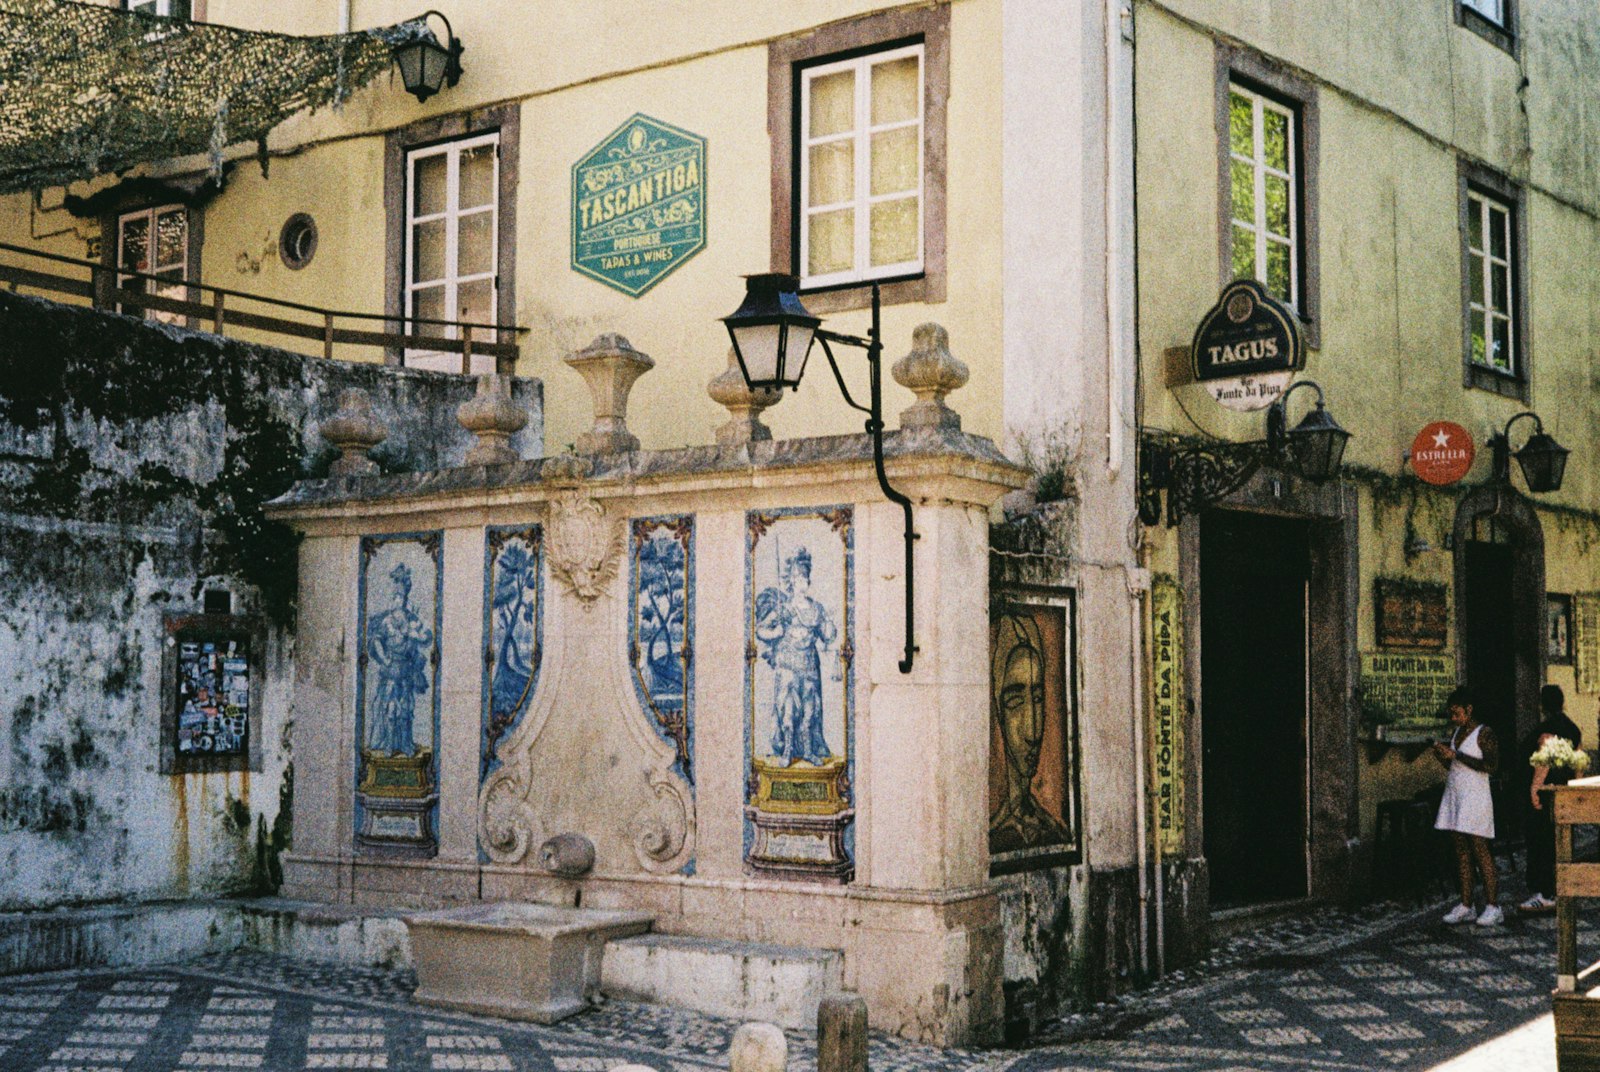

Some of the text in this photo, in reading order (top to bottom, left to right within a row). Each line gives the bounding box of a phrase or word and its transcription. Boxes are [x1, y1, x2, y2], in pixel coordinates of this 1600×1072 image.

[579, 159, 699, 230] TASCANTIGA
[601, 255, 630, 270] TAPAS
[643, 247, 673, 263] WINES
[1208, 337, 1278, 364] TAGUS
[1259, 383, 1281, 398] Pipa
[1416, 449, 1466, 461] ESTRELLA
[1159, 610, 1172, 829] BAR FONTE DA PIPA
